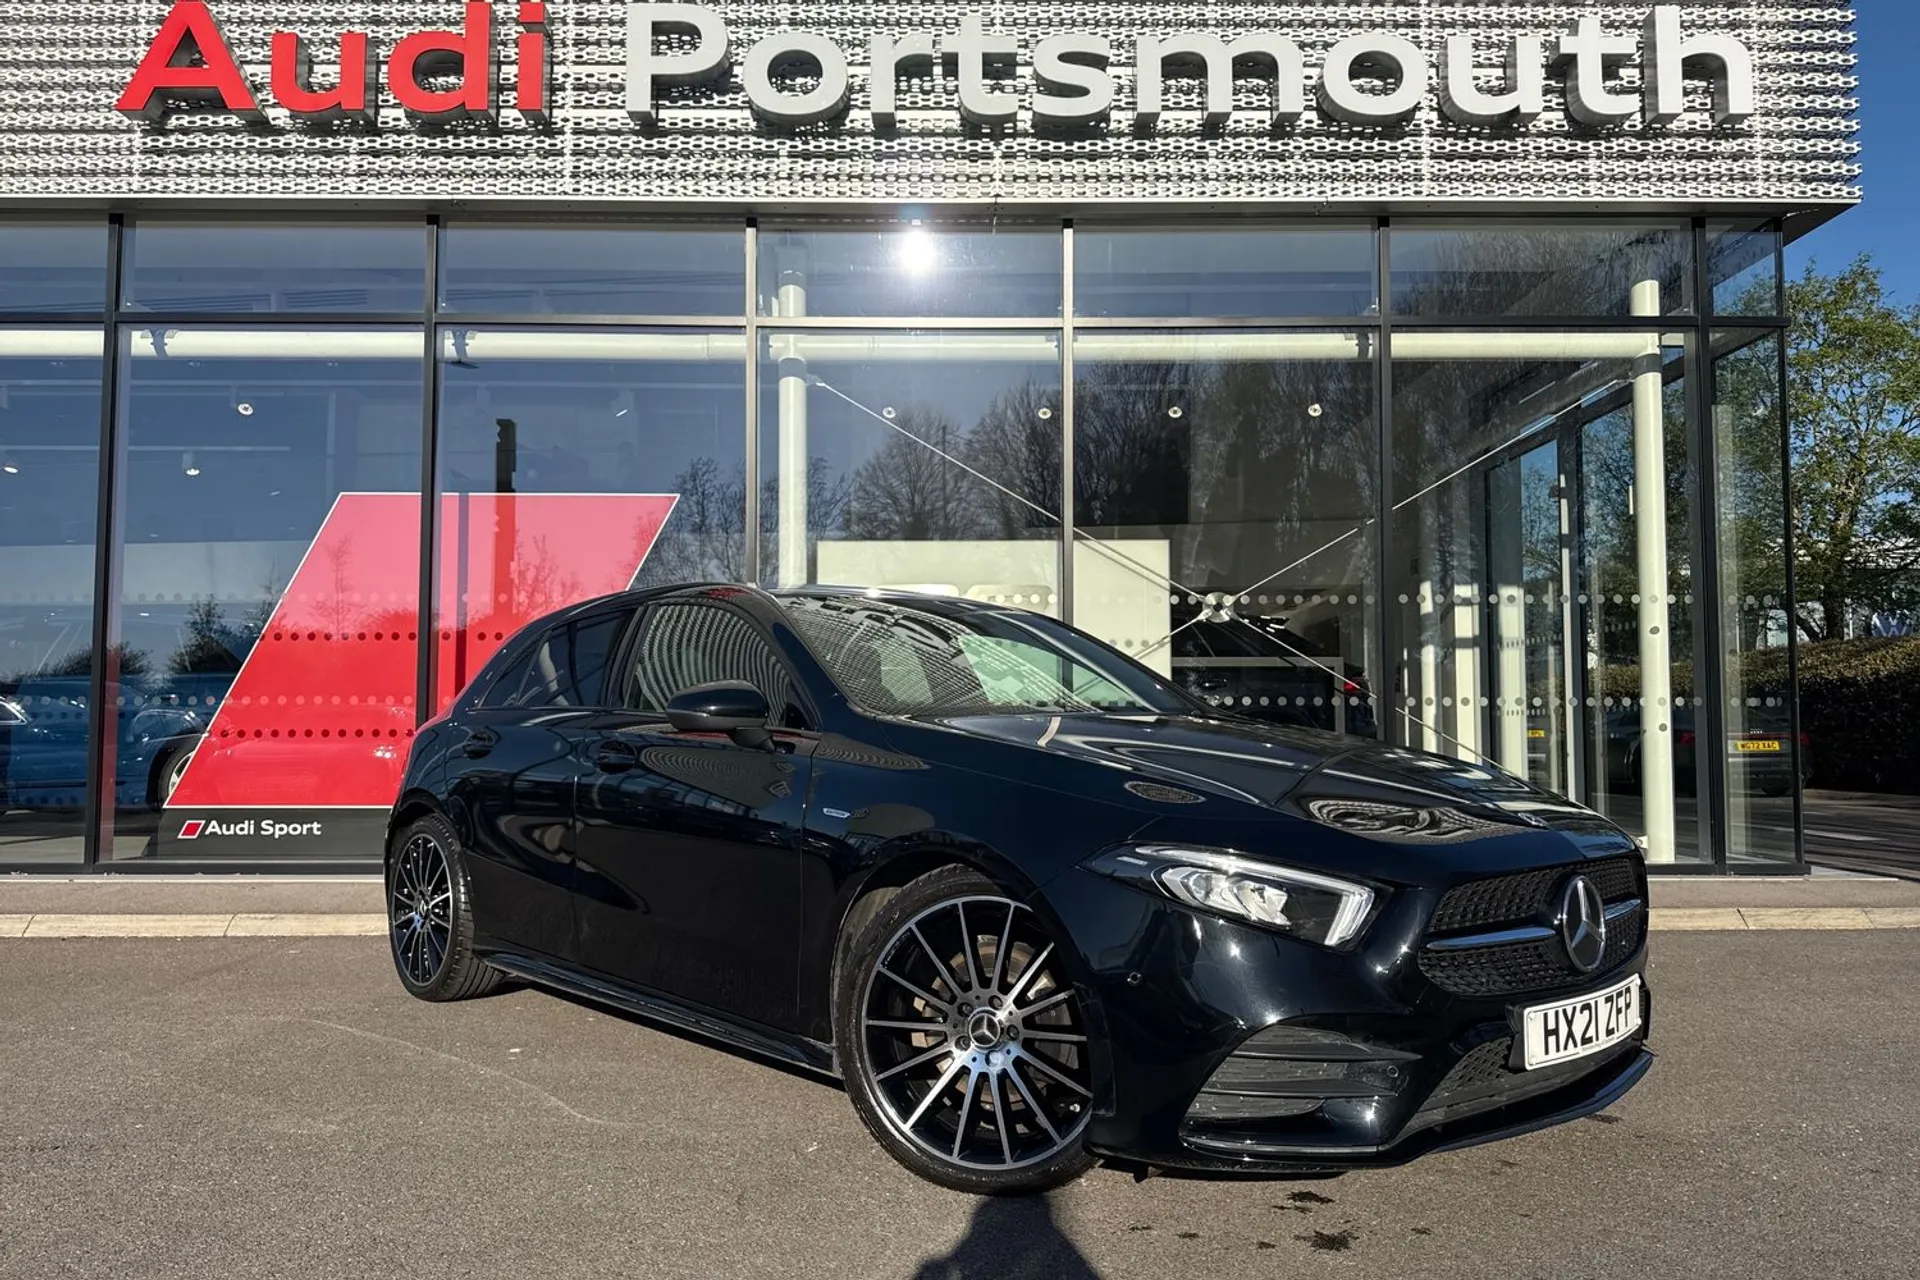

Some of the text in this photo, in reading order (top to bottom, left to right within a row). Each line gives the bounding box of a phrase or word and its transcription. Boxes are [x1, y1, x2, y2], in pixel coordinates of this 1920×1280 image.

[116, 0, 1755, 119] Audi Portsmouth
[204, 819, 322, 839] Audi Sport
[1543, 985, 1632, 1056] HX21 ZFP
